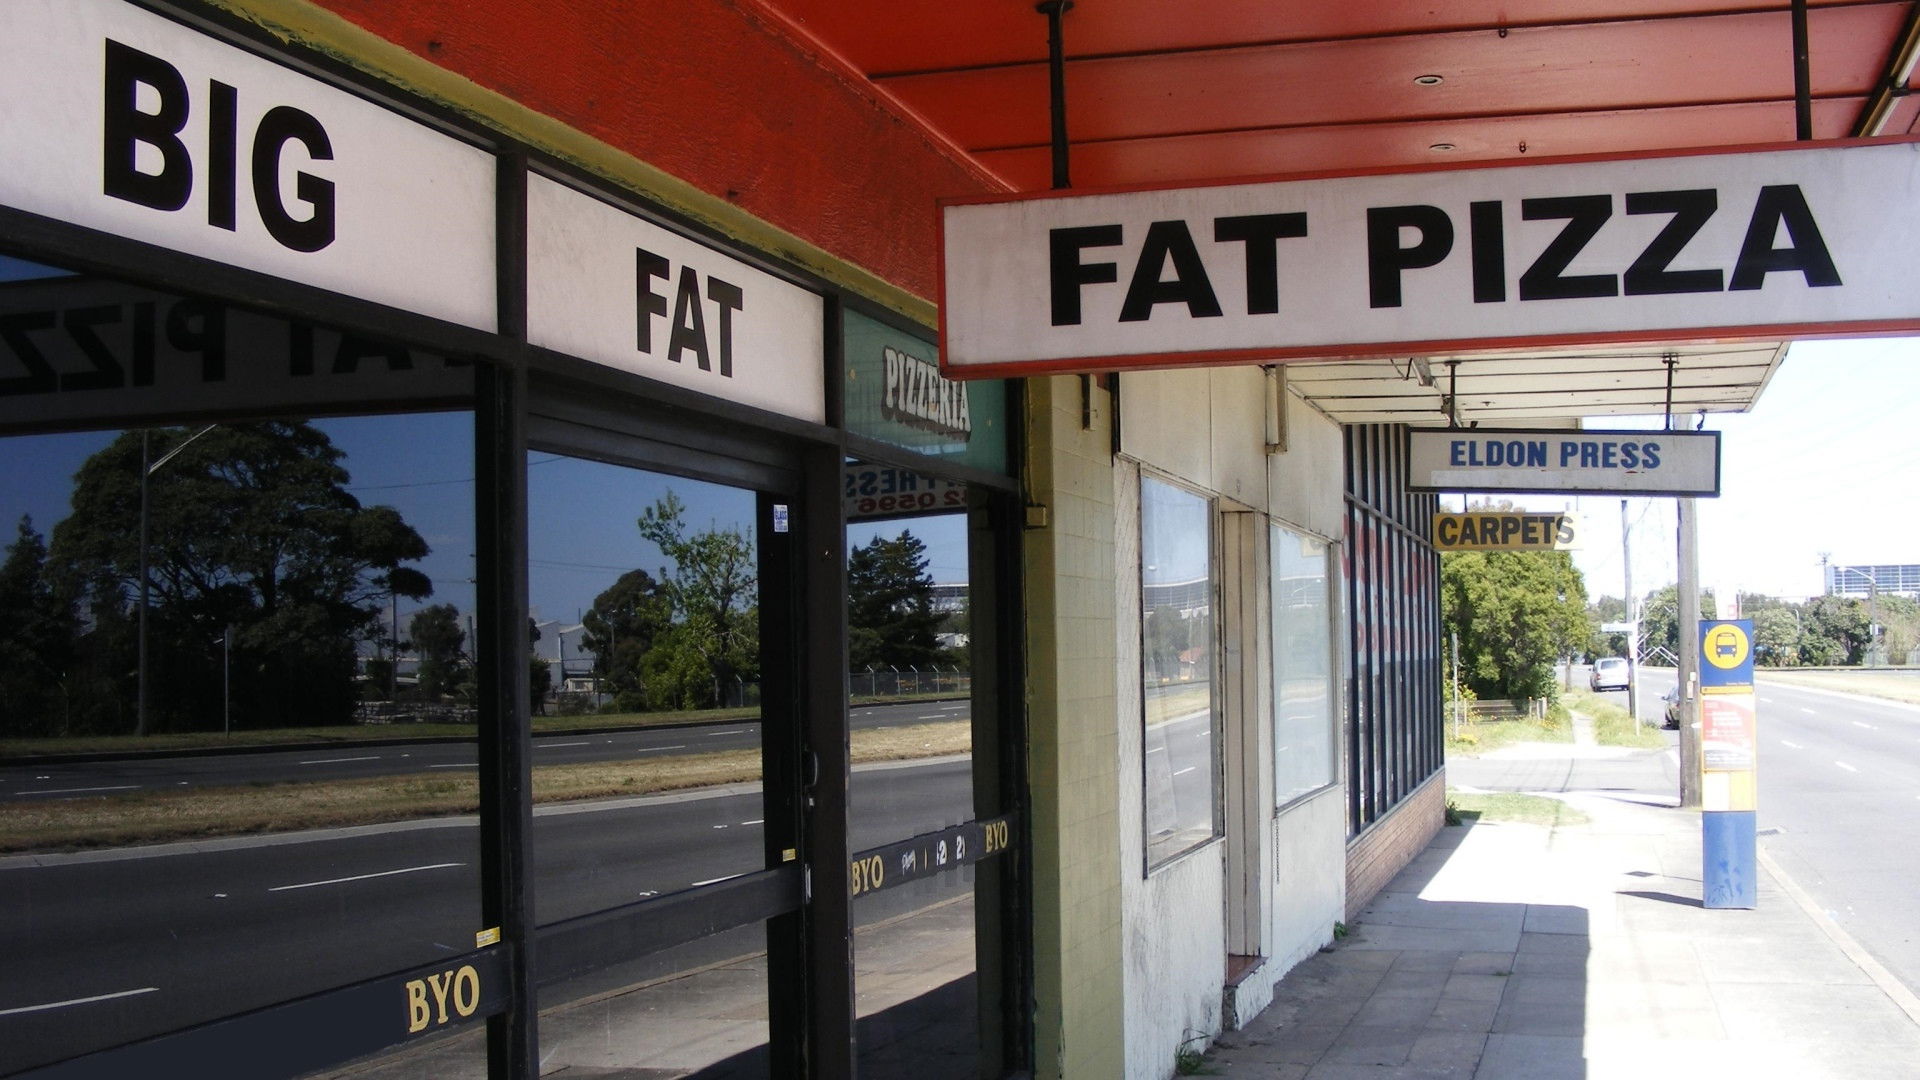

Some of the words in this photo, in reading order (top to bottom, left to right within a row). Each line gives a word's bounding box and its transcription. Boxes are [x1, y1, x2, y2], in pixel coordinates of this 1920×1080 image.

[104, 37, 336, 253] BIG
[1049, 211, 1308, 327] FAT
[1367, 184, 1843, 309] PIZZA
[636, 247, 743, 378] FAT
[884, 347, 971, 433] PIZZERIA
[1450, 440, 1547, 467] ELDON
[1560, 441, 1661, 469] PRESS
[1438, 516, 1575, 546] CARPETS
[851, 854, 884, 896] BYO
[986, 820, 1008, 853] BYO
[406, 965, 480, 1032] BYO
